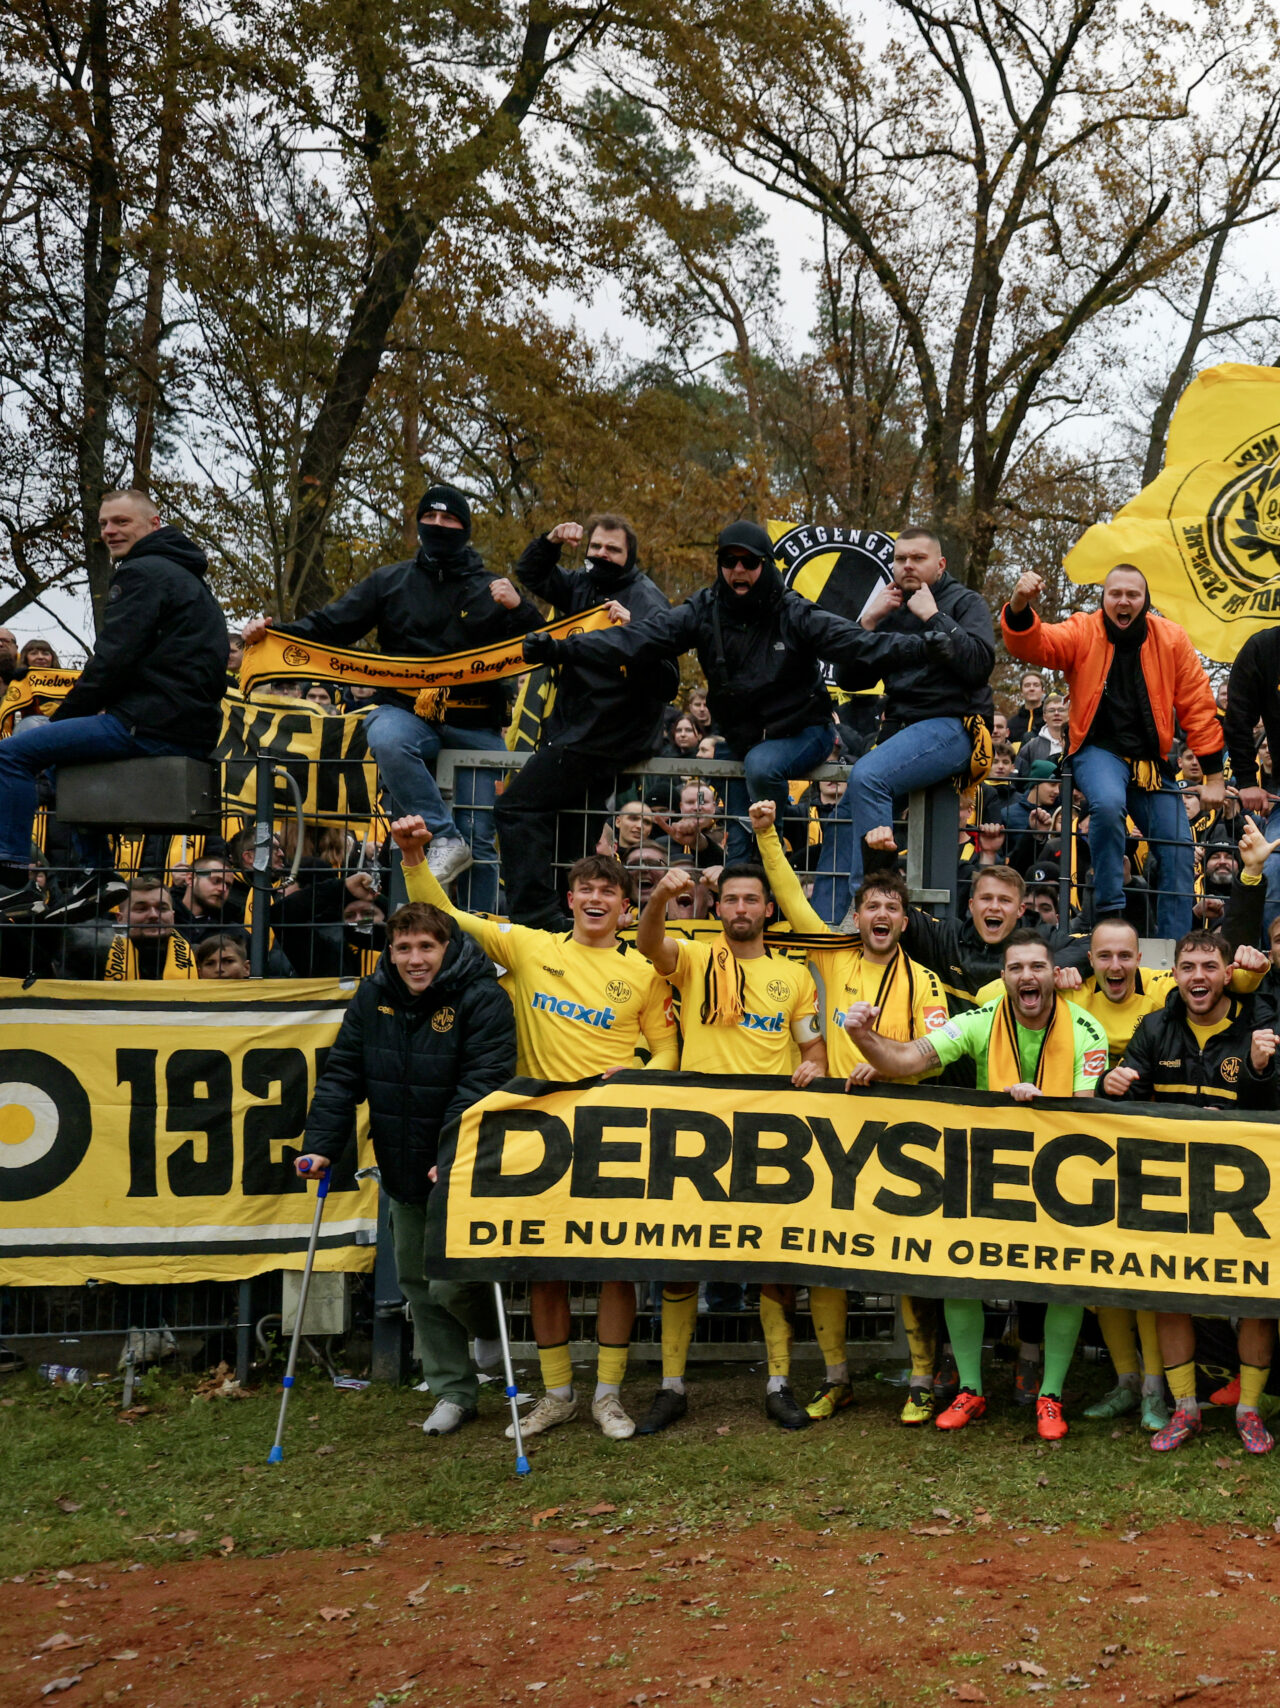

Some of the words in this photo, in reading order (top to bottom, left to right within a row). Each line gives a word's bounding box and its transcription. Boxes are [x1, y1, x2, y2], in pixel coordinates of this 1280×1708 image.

[531, 991, 616, 1030] maxit
[739, 1011, 785, 1033] axit
[471, 1106, 1271, 1239] DERBYSIEGER
[469, 1219, 546, 1246] DIE
[564, 1220, 763, 1249] NUMMER
[781, 1226, 876, 1257] EINS
[891, 1236, 932, 1263] IN
[947, 1239, 1270, 1286] OBERFRANKEN
